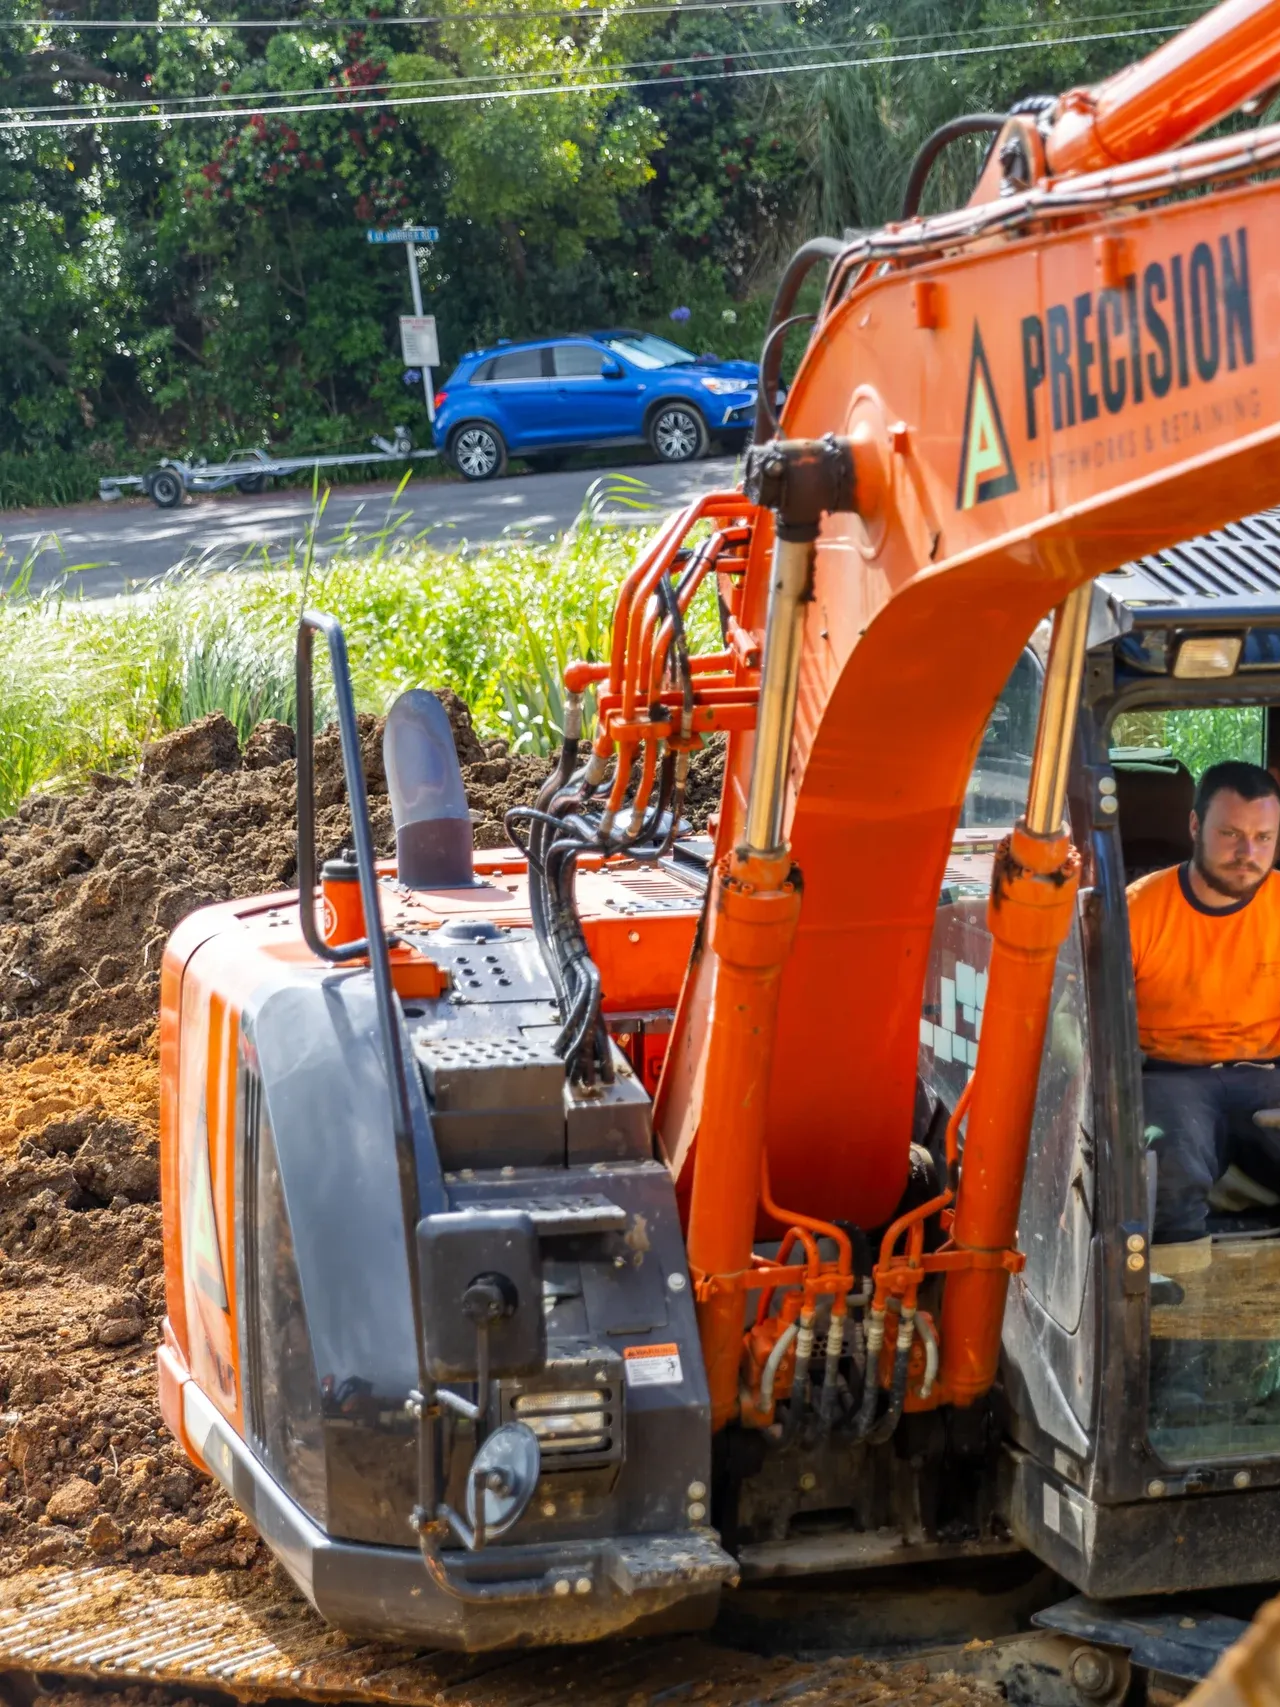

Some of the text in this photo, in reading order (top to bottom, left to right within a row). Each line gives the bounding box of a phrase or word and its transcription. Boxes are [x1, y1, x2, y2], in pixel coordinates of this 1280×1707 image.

[1021, 227, 1255, 439] PRECISION
[1028, 387, 1262, 488] EARTHWORKS & RETAINING
